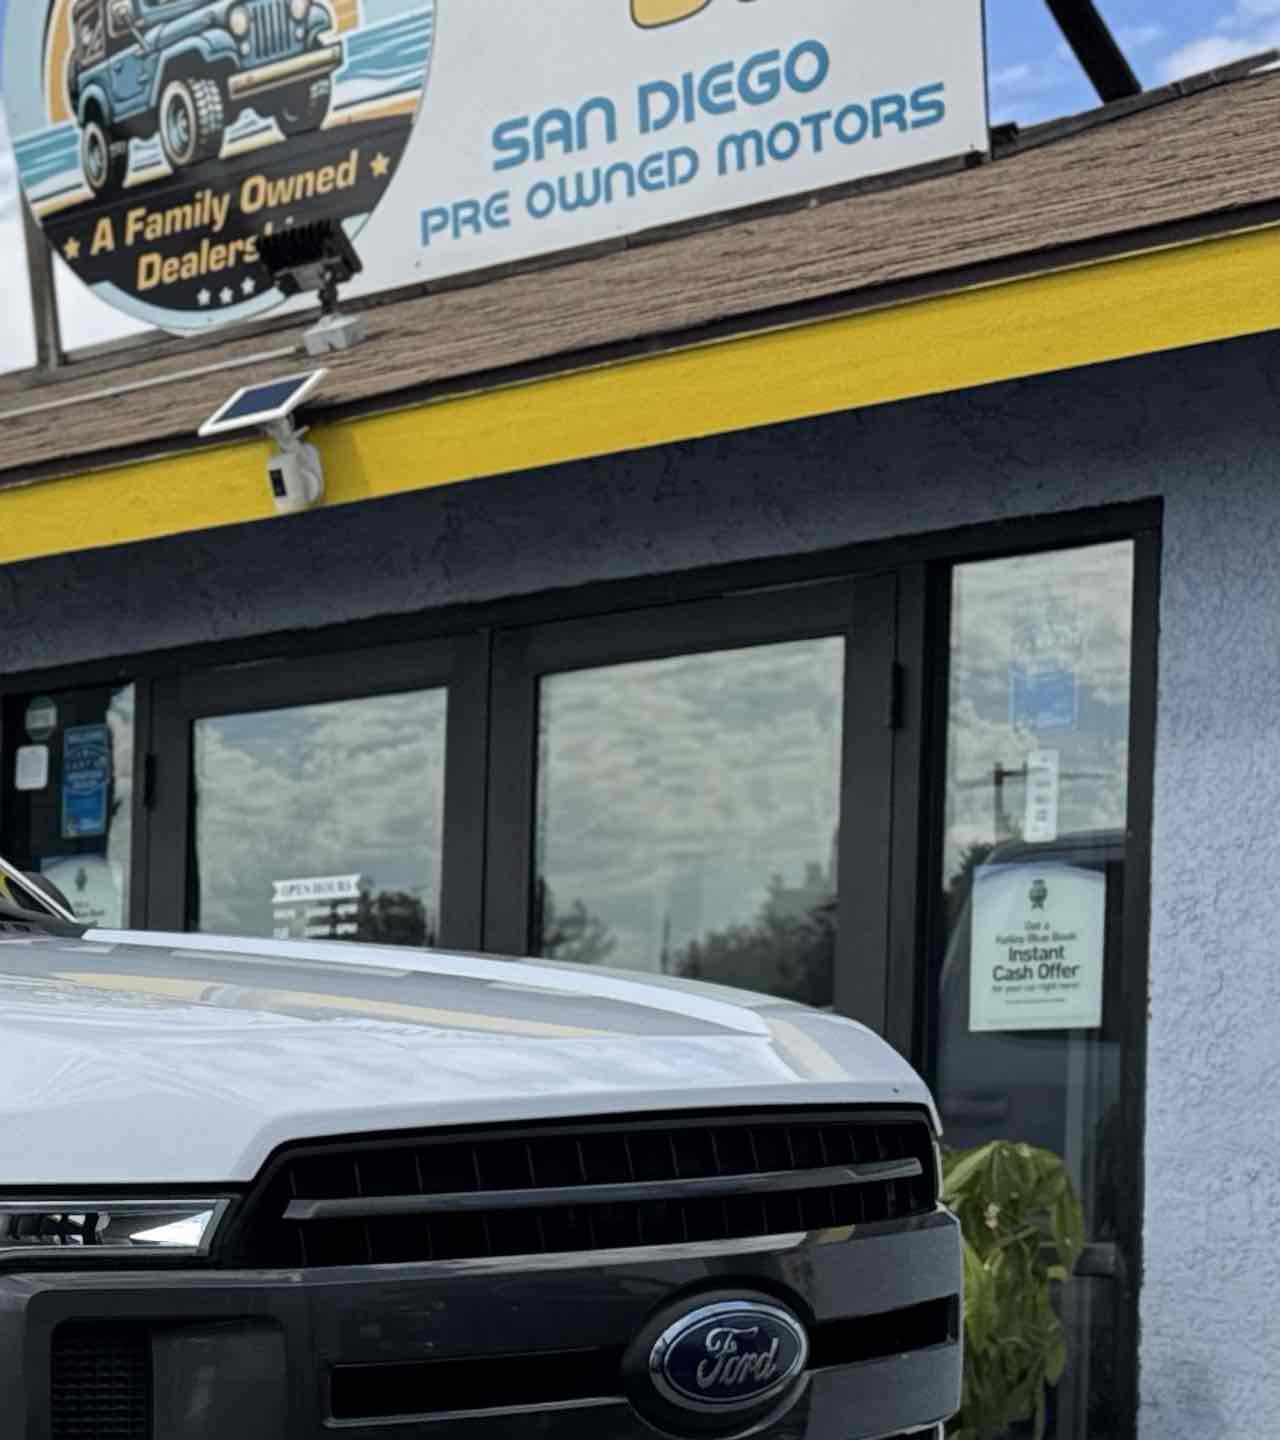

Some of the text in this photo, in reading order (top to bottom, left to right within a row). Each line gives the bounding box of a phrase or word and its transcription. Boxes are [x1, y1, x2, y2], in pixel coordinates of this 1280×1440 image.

[492, 38, 830, 172] SAN DIEGO
[420, 81, 946, 247] PRE OWNED MOTORS
[91, 149, 359, 255] A Family Owned
[137, 220, 292, 290] Dealers
[992, 963, 1080, 981] Cash Offer
[1008, 945, 1065, 962] Instant
[696, 1326, 779, 1389] Ford
